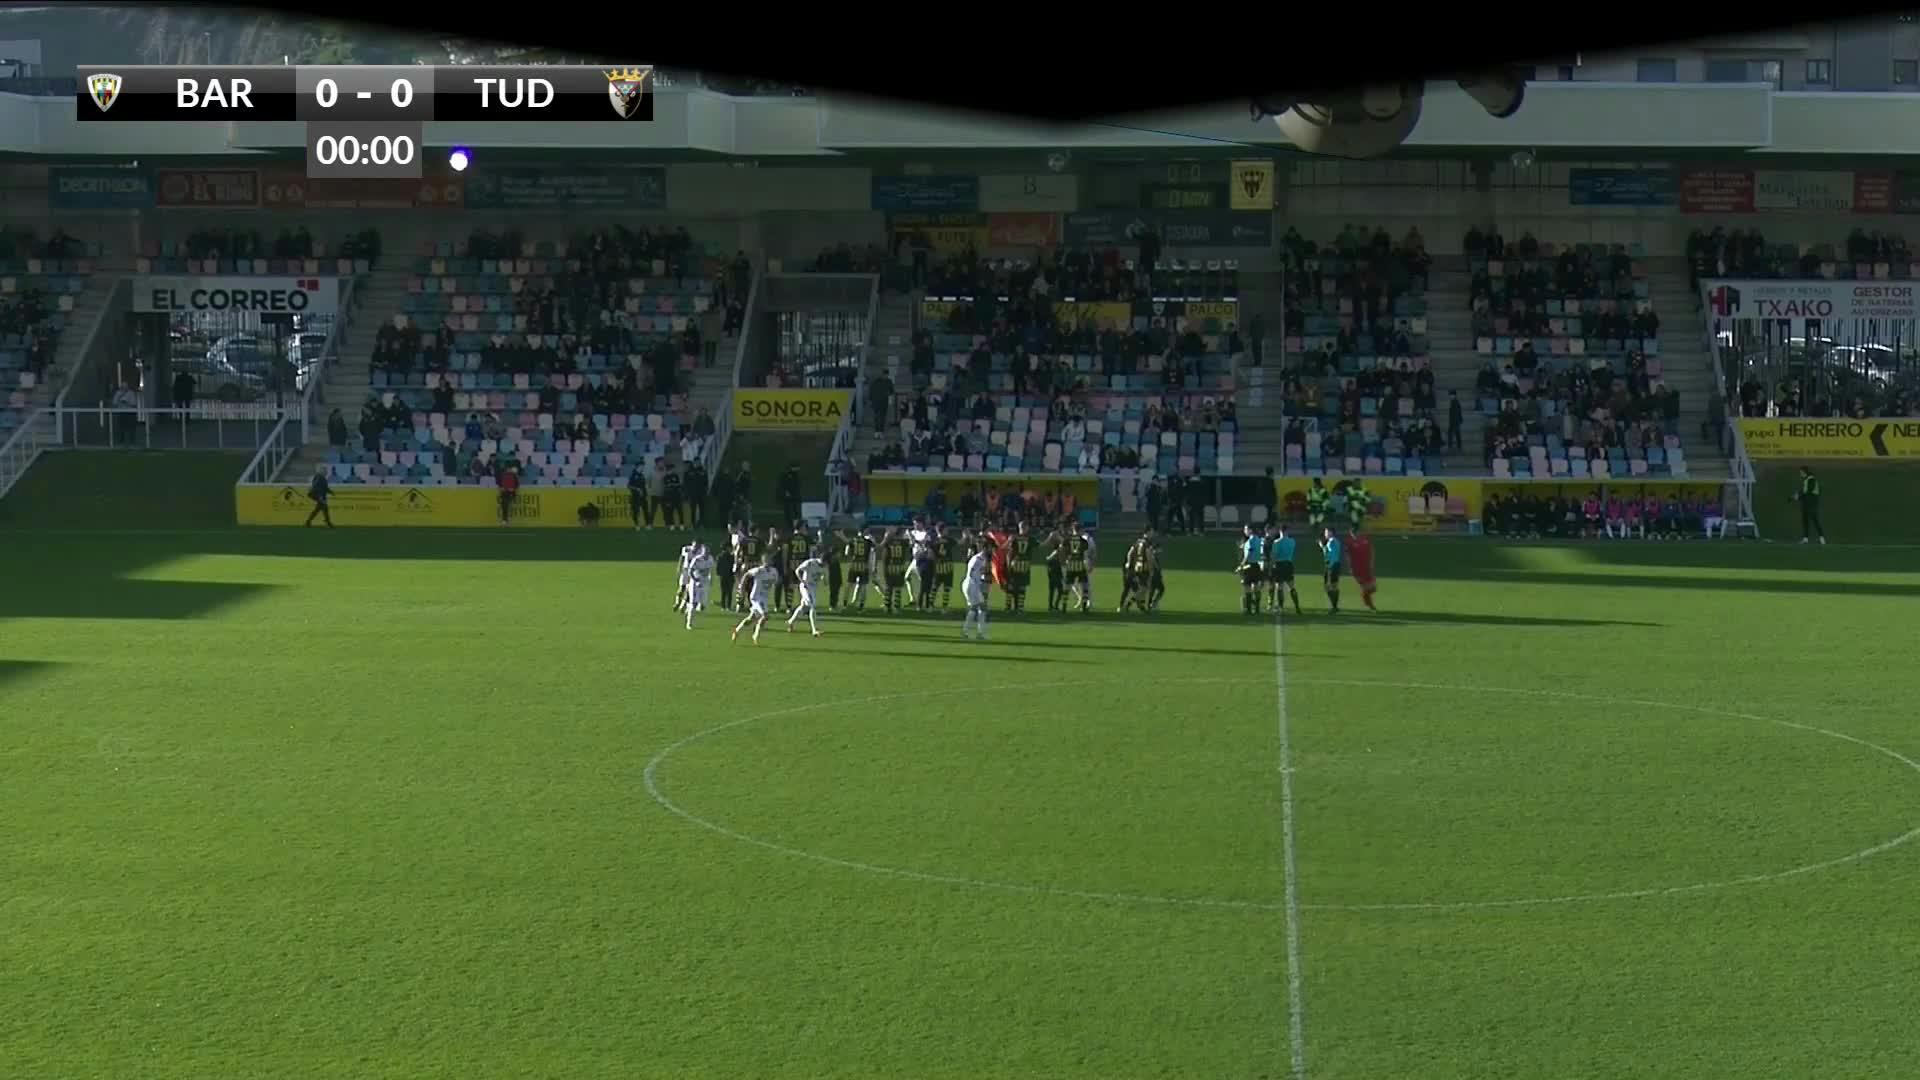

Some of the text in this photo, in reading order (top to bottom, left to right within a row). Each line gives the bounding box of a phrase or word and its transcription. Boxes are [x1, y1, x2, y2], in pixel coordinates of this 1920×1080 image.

[152, 289, 308, 311] EL CORREO
[1853, 287, 1912, 297] GESTOR
[1753, 299, 1832, 317] TXAKO
[741, 400, 841, 417] SONORA
[1745, 423, 1863, 439] grupo HERRERO
[597, 490, 633, 507] urba
[791, 540, 806, 554] 20
[1017, 540, 1028, 553] 17
